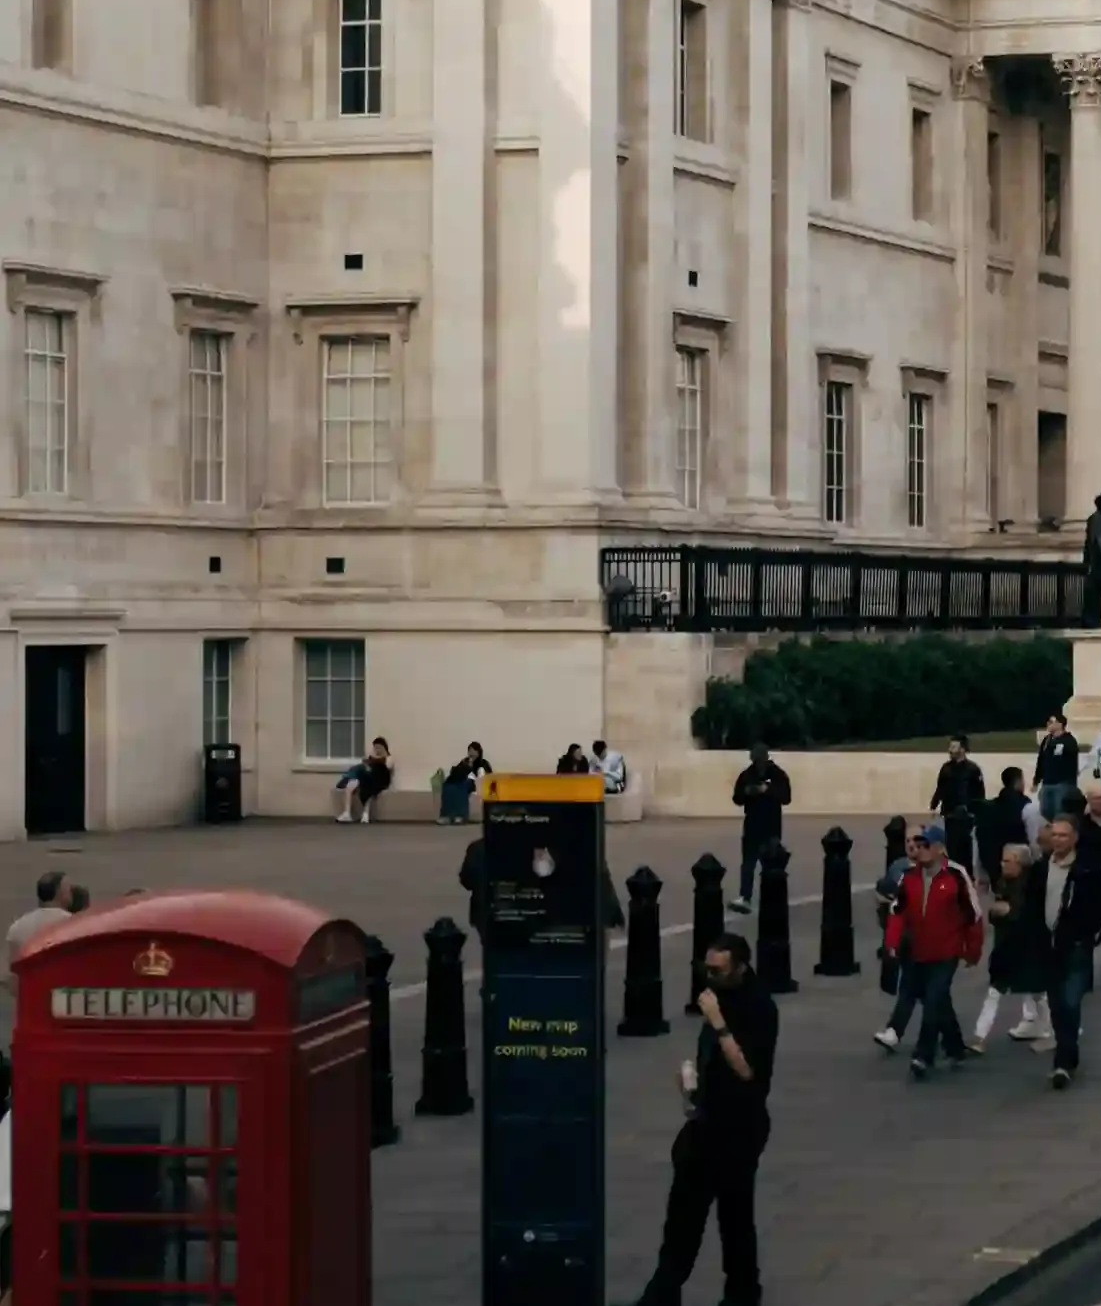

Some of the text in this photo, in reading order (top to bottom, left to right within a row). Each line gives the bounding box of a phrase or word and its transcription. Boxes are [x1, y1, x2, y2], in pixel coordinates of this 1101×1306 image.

[60, 989, 248, 1017] TELEPHONE
[507, 1015, 542, 1032] New
[493, 1043, 588, 1060] coming soon
